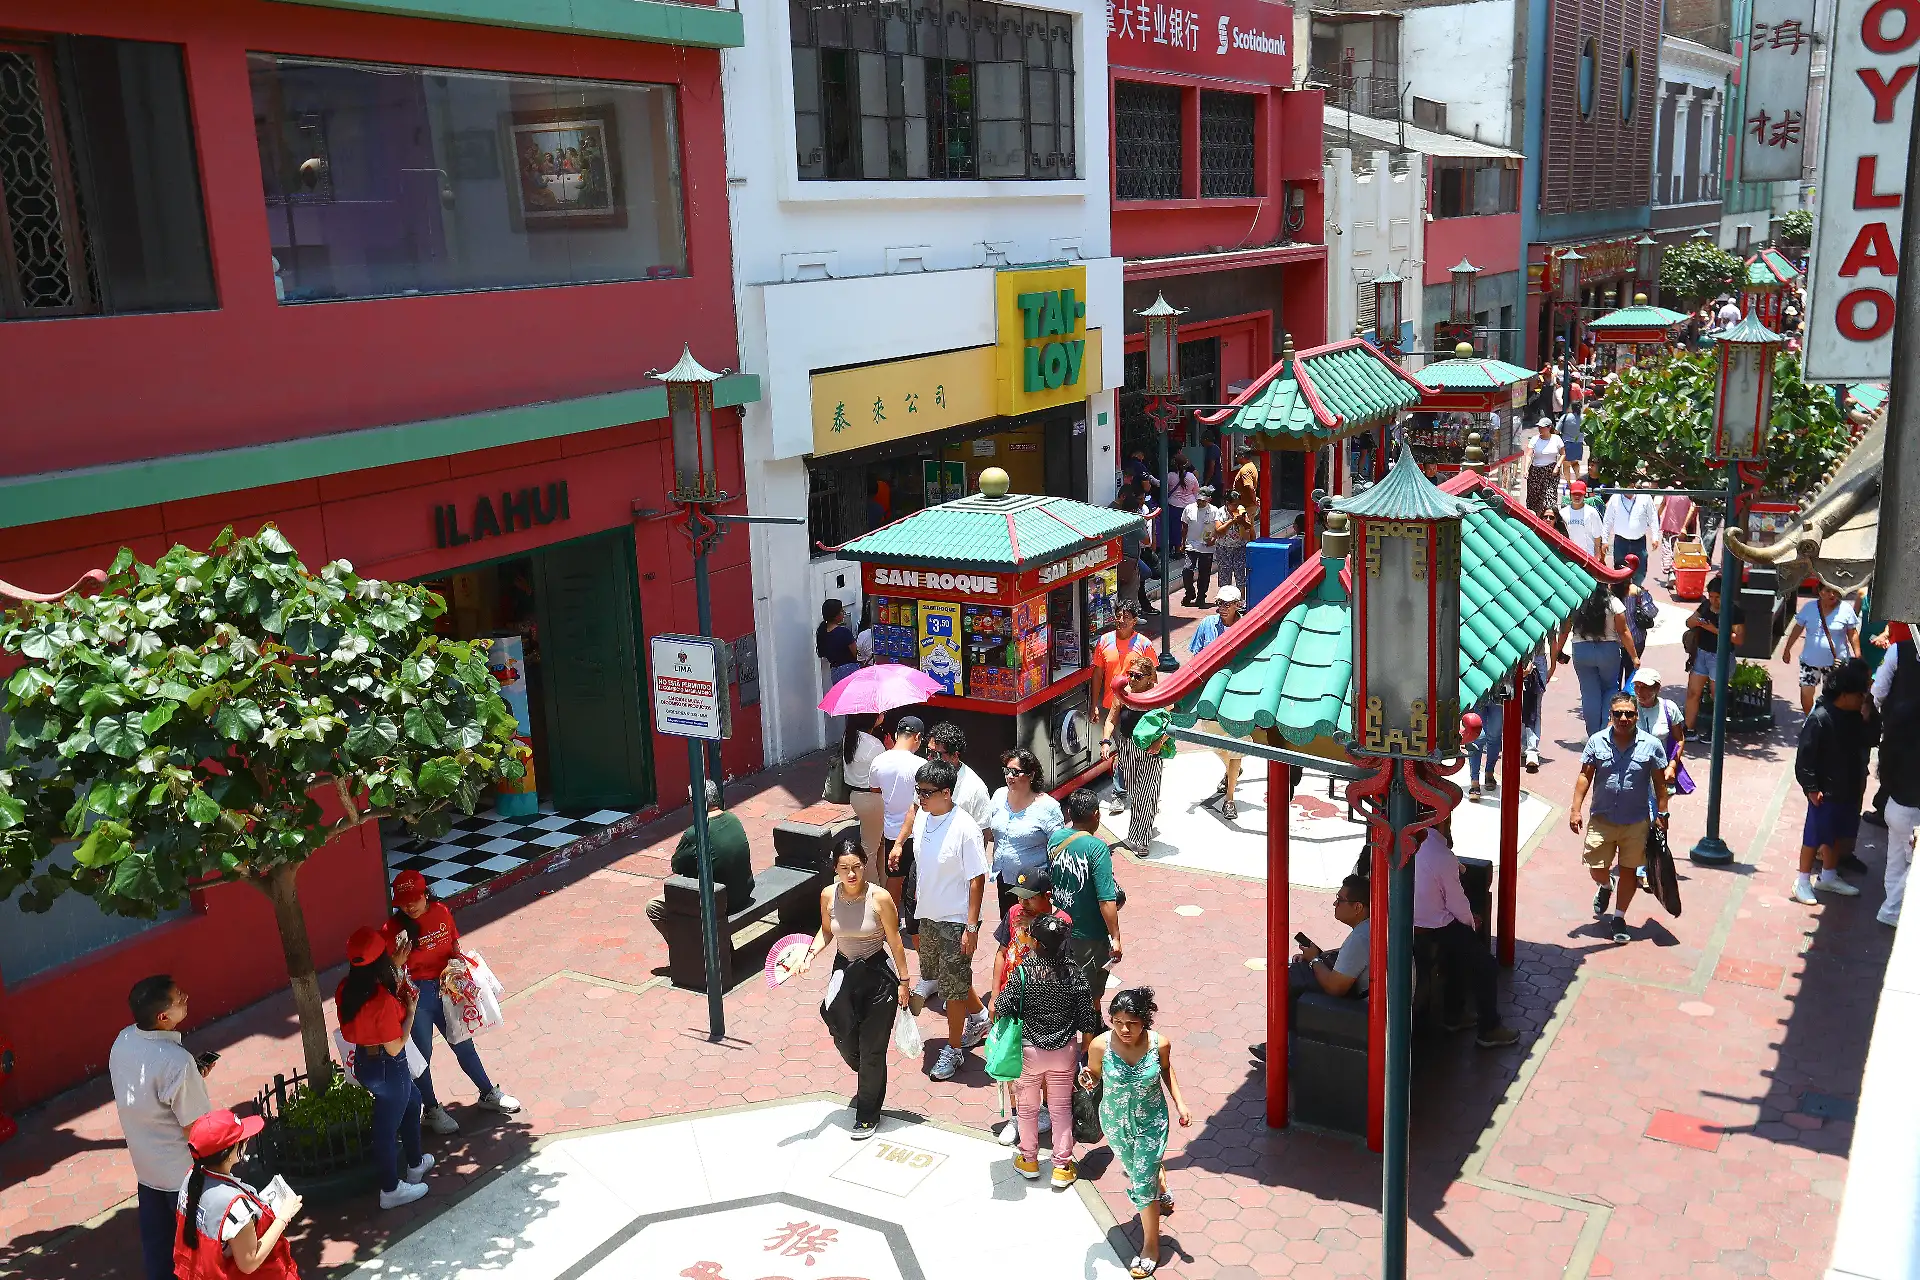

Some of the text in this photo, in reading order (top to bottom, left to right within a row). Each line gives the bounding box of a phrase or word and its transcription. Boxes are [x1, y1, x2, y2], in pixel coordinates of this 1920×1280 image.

[1232, 26, 1286, 56] Scotiabank
[1023, 340, 1086, 392] LOY
[435, 480, 571, 549] ILAHUI
[875, 568, 998, 595] SAN ROQUE
[1038, 545, 1108, 584] SAN ROQUE
[674, 665, 692, 673] LIMA
[875, 1143, 934, 1169] GML
[762, 1220, 839, 1267] 猴
